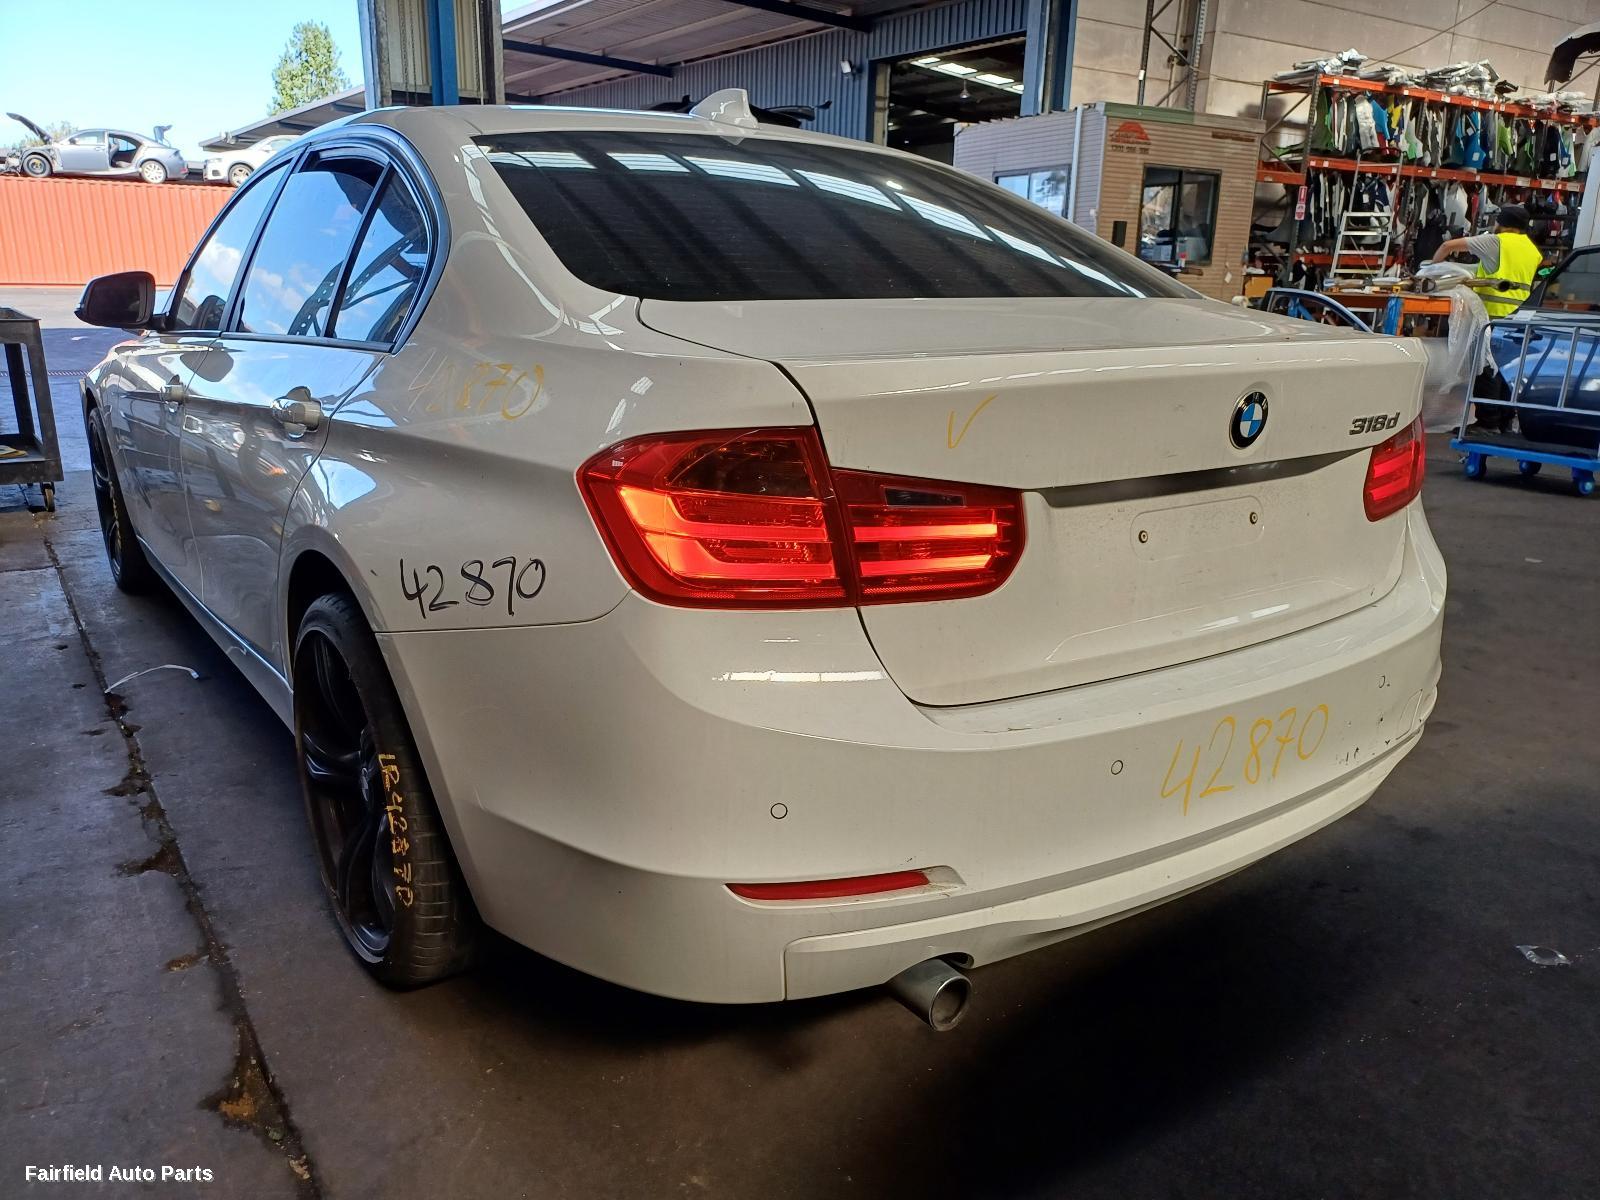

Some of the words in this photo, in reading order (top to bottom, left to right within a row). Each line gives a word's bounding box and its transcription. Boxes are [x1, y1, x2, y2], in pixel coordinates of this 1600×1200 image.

[1349, 411, 1400, 435] 318d
[400, 556, 546, 619] 42870
[1160, 704, 1329, 816] 42870
